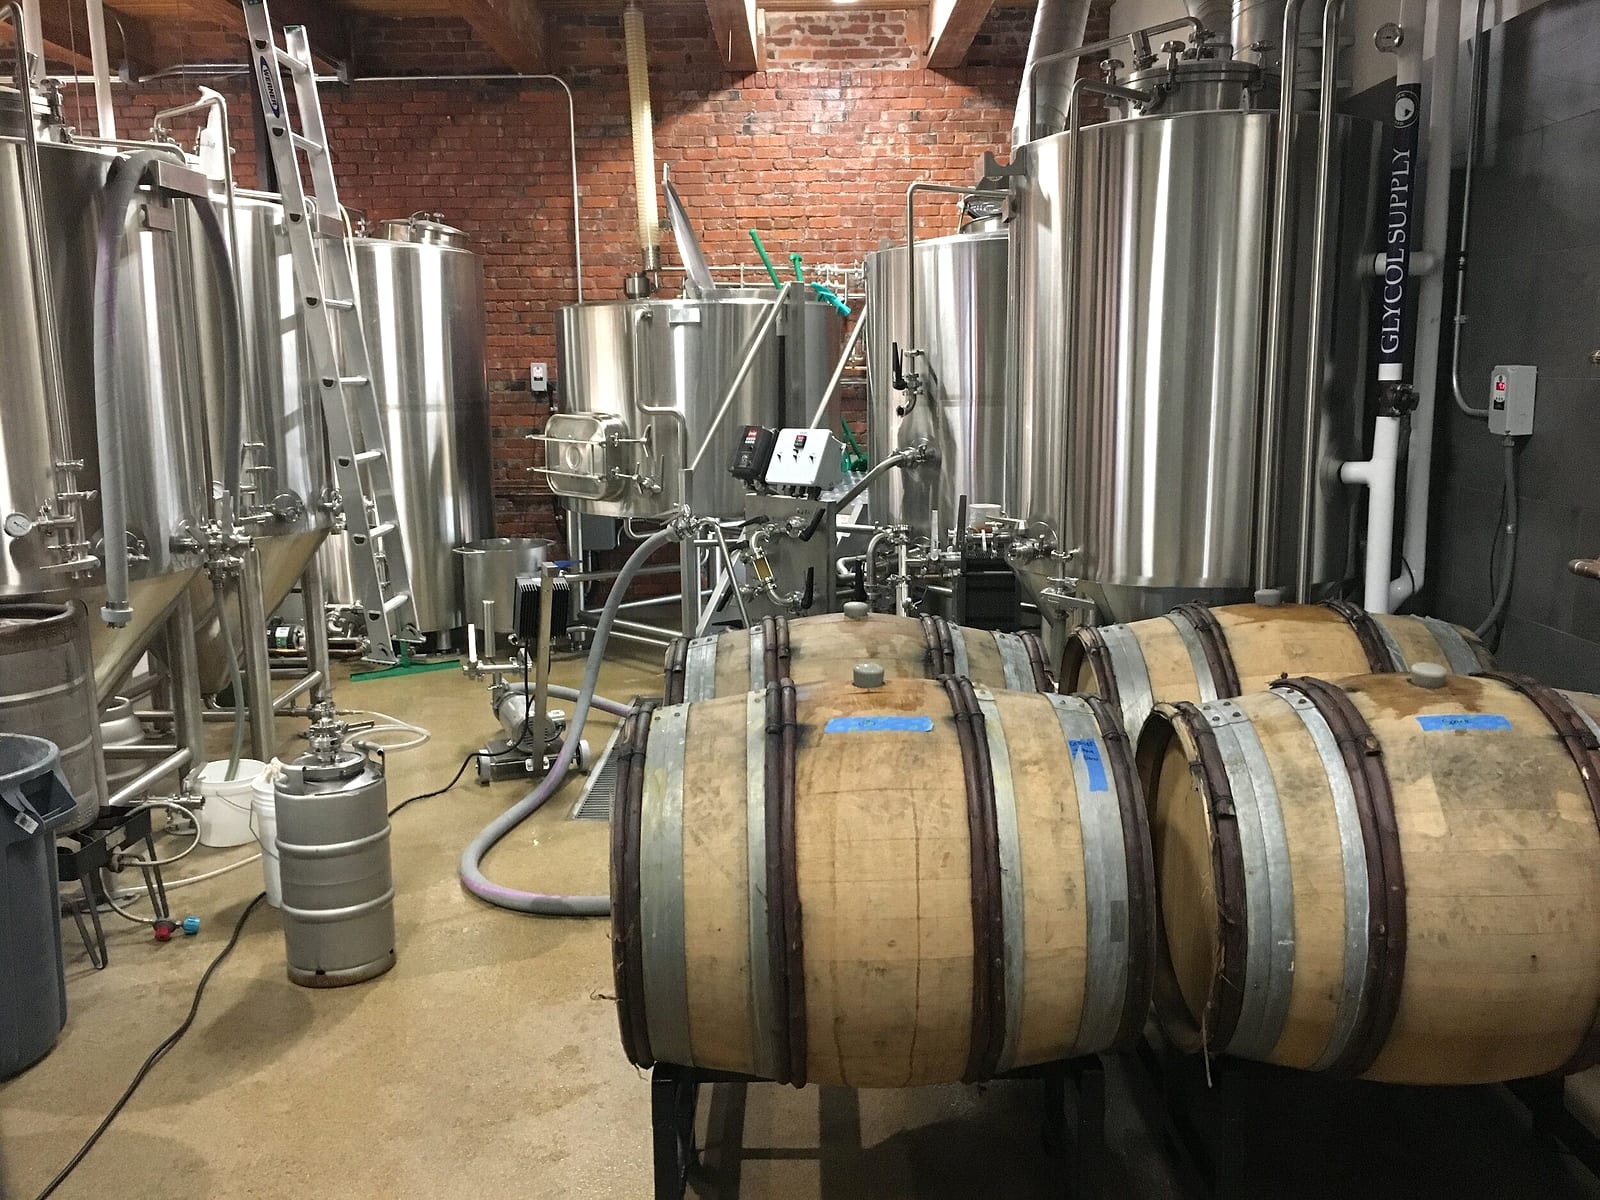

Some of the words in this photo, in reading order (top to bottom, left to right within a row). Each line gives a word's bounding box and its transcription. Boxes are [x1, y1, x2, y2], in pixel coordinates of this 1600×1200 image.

[264, 68, 277, 106] WERNER
[1387, 148, 1410, 243] SUPPLY
[1380, 248, 1405, 354] GLYCOL
